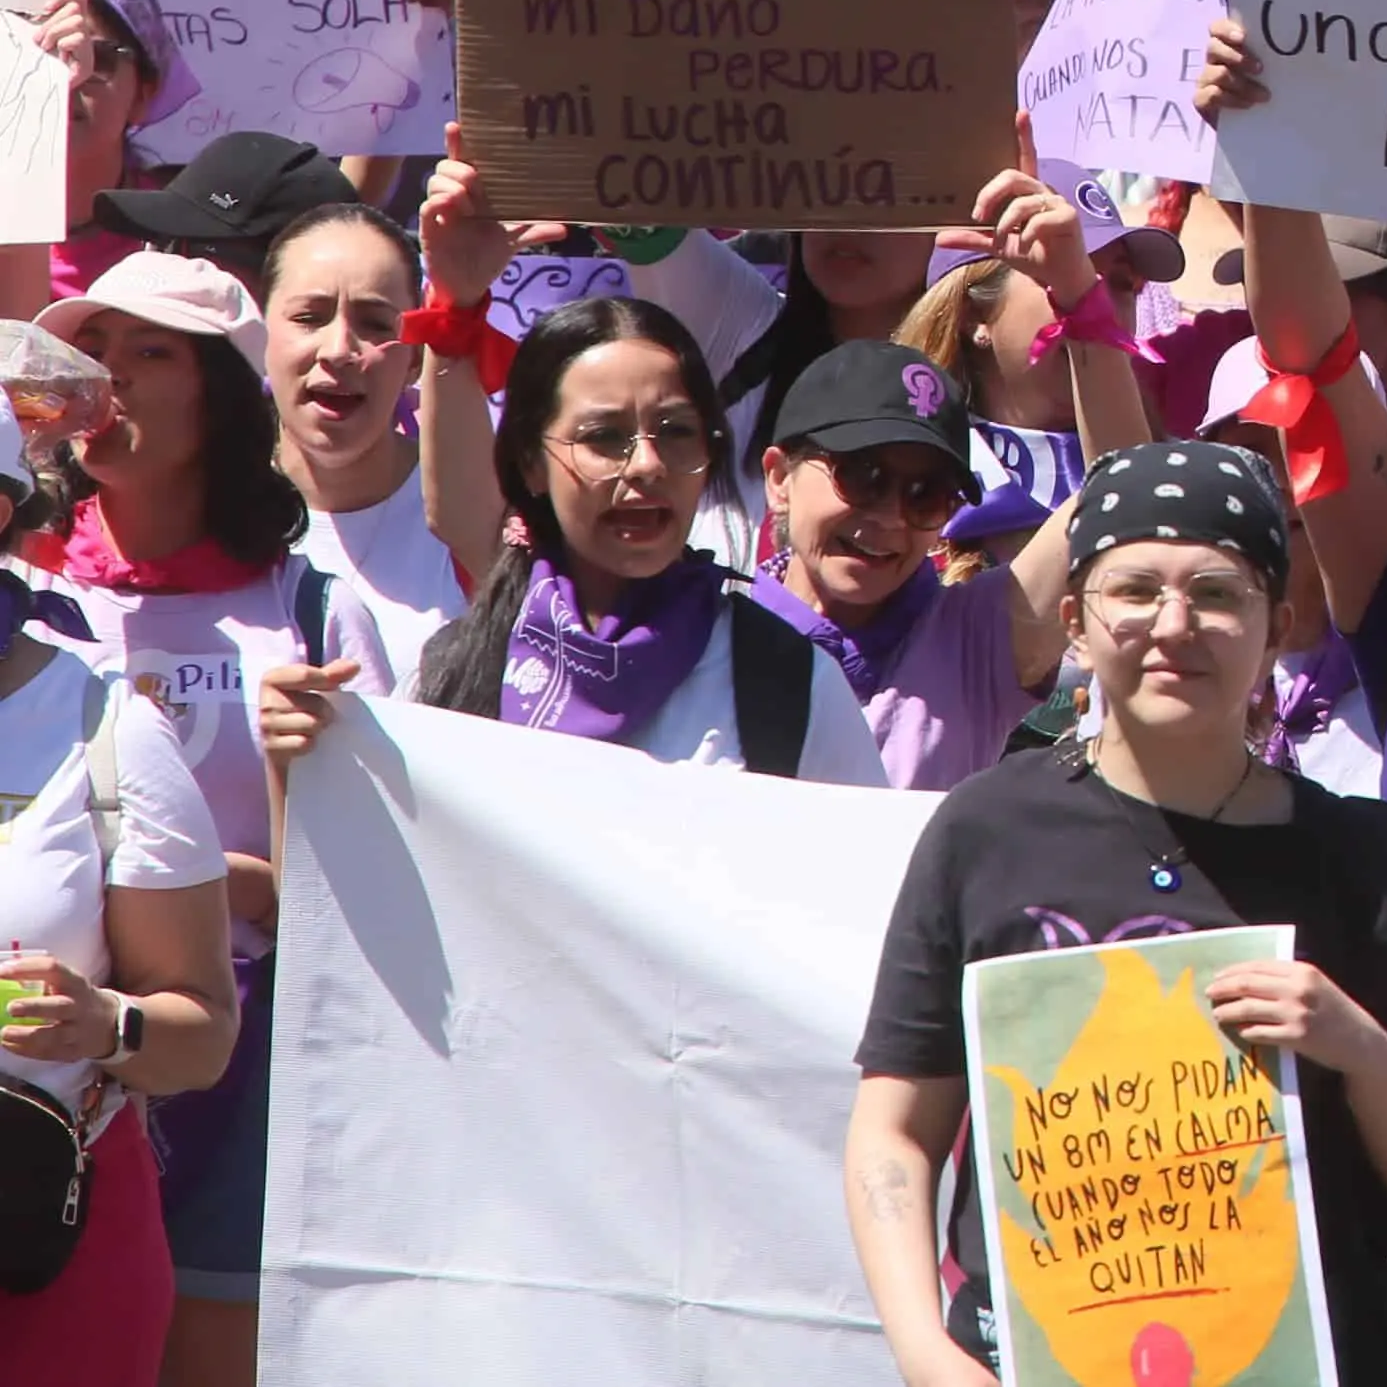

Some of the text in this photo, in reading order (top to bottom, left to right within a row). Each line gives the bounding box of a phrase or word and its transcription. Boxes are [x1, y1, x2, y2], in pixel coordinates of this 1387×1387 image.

[1090, 36, 1150, 79] NOS
[523, 85, 595, 142] mi
[175, 659, 243, 695] Pili
[1025, 1044, 1263, 1141] NO NOS PIDAN
[1002, 1104, 1277, 1185] UN 8M EN CALMA
[1031, 1157, 1239, 1231] CUANDO TODO
[1029, 1197, 1244, 1268] EL AÑO NOS LA
[1088, 1241, 1207, 1294] QUITAN
